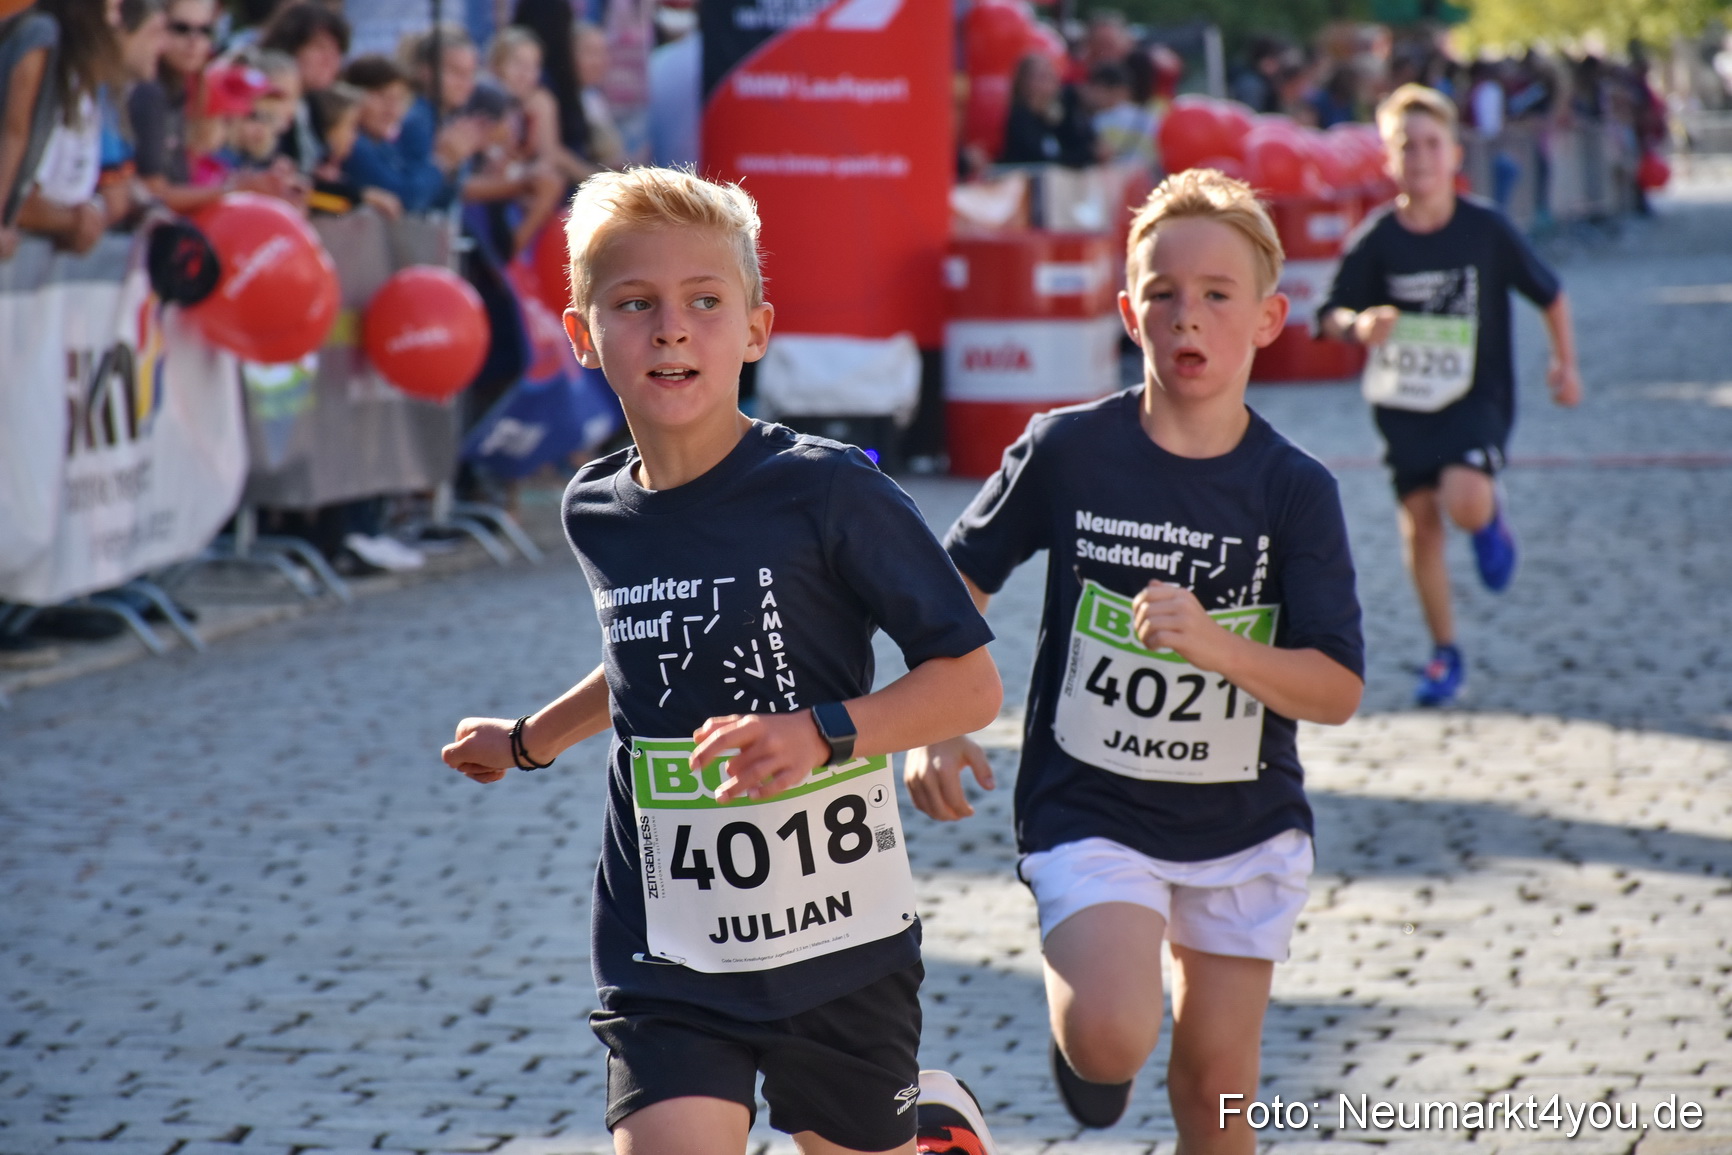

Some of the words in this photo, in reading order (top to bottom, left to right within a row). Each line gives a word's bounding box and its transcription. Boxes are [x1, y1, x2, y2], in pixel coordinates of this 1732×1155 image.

[1075, 510, 1214, 549] Neumarkter
[1075, 538, 1184, 575] Stadtlauf
[1251, 534, 1270, 605] BAMBI
[603, 610, 673, 645] adtlauf
[758, 567, 799, 711] BAMBINI
[1085, 655, 1238, 722] 4021
[1103, 730, 1210, 762] JAKOB
[670, 793, 873, 891] 4018
[709, 891, 853, 944] JULIAN
